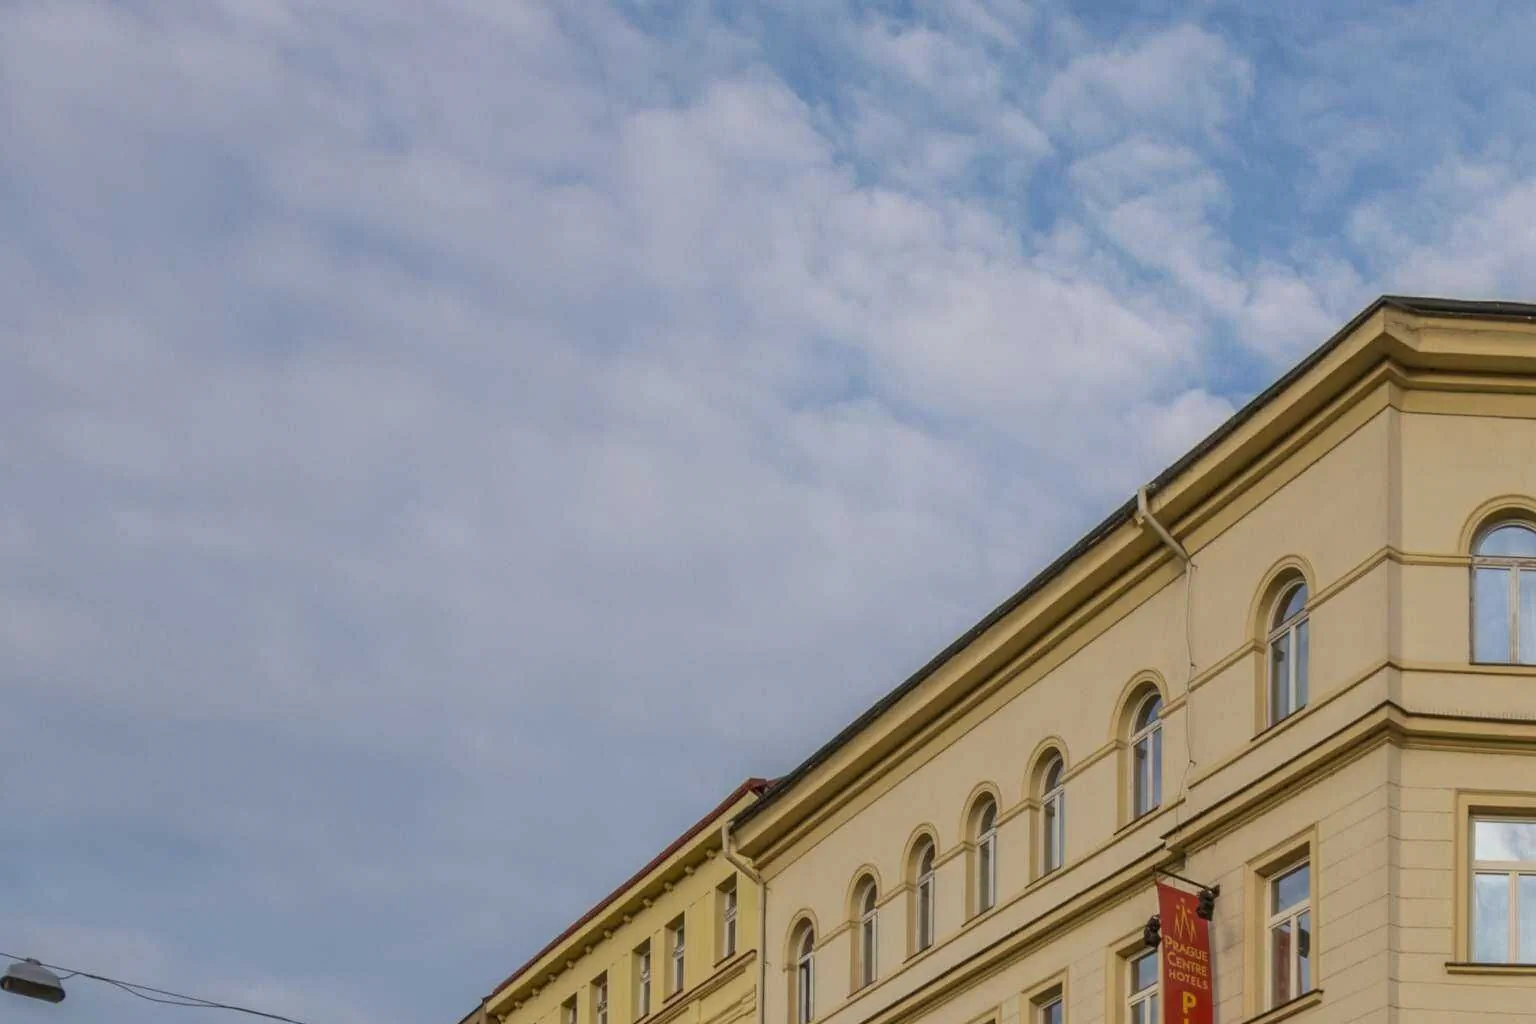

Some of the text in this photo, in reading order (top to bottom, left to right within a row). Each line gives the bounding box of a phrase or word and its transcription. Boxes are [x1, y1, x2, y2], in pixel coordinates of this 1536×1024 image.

[1164, 935, 1209, 962] PRAGUE
[1167, 951, 1209, 977] CENTRE
[1168, 968, 1209, 989] HOTELS
